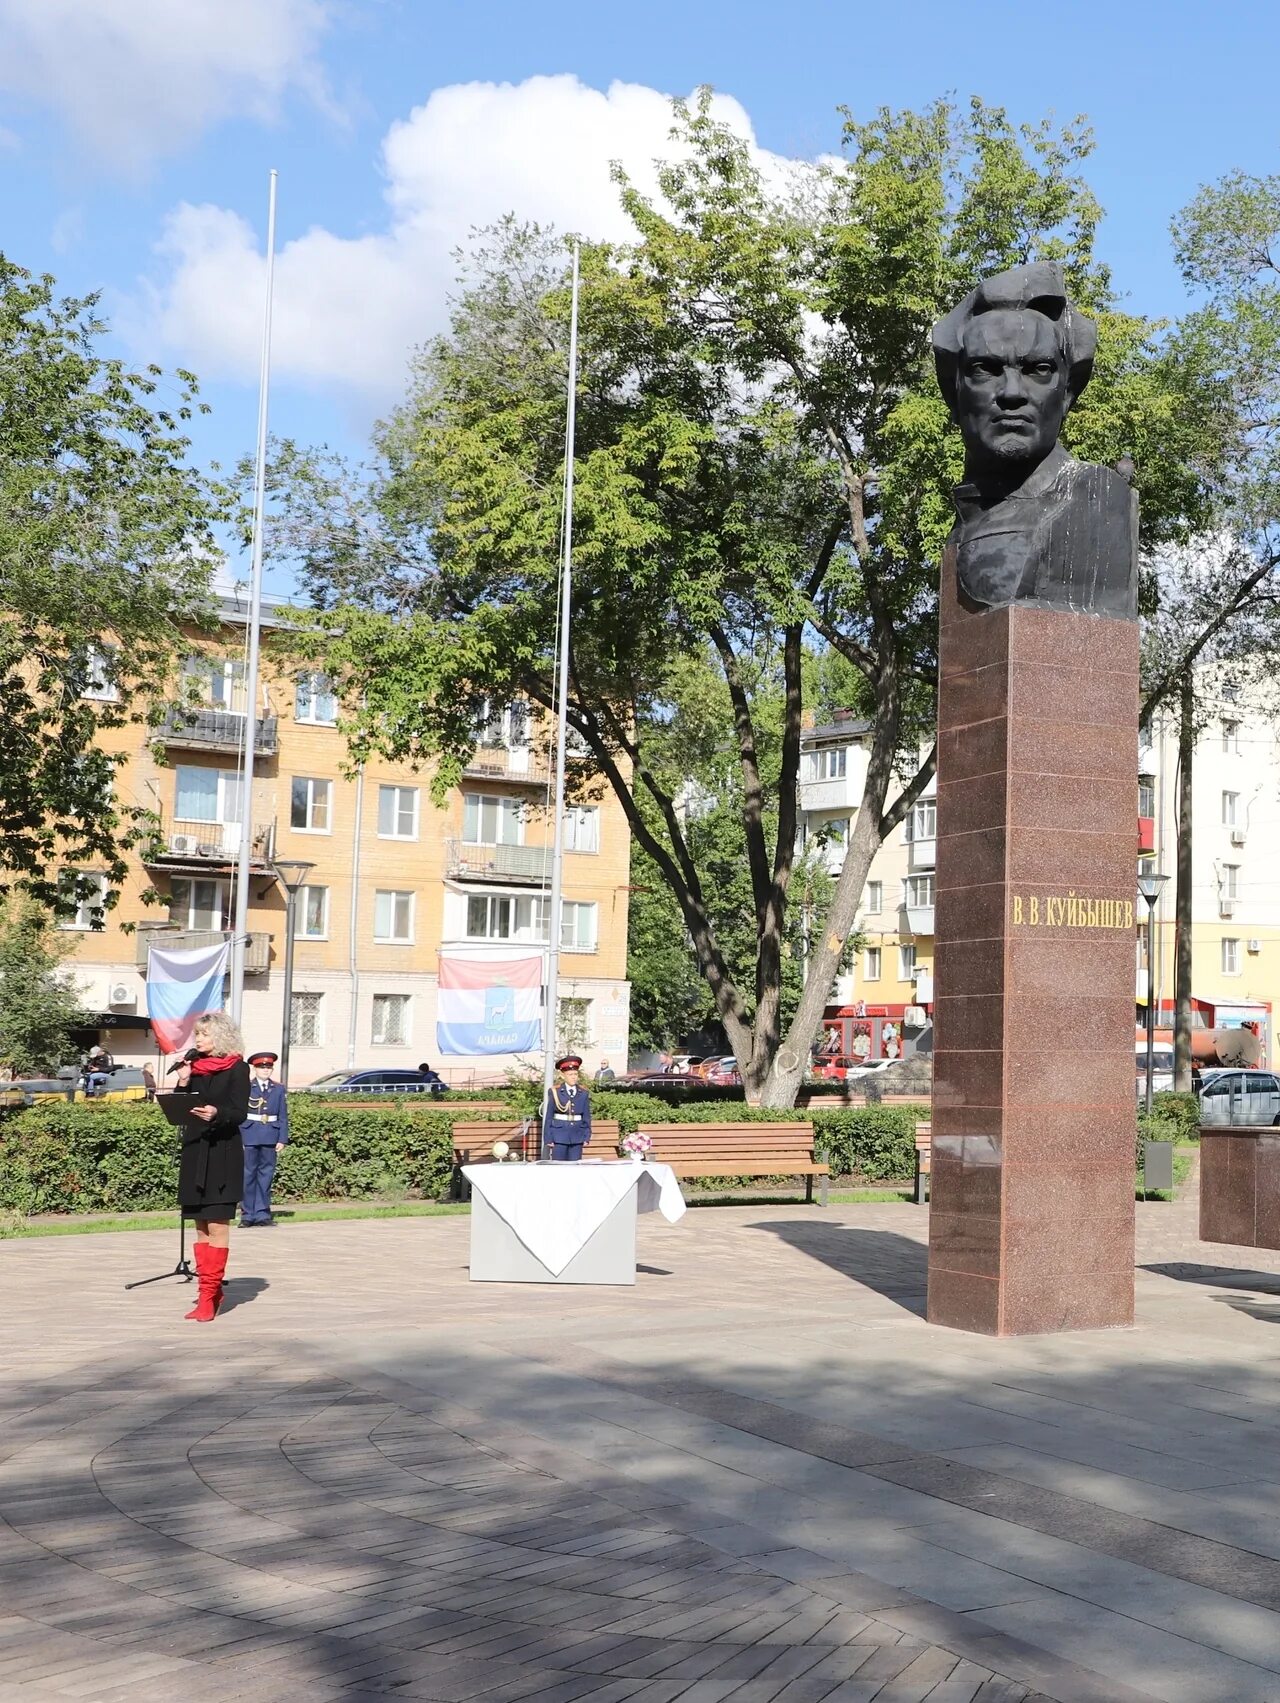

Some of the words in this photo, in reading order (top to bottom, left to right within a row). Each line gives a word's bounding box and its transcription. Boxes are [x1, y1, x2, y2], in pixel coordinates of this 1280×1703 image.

[1013, 895, 1026, 925] В.
[1030, 896, 1043, 925] В.
[1046, 889, 1133, 929] КУЙБЫШЕВ
